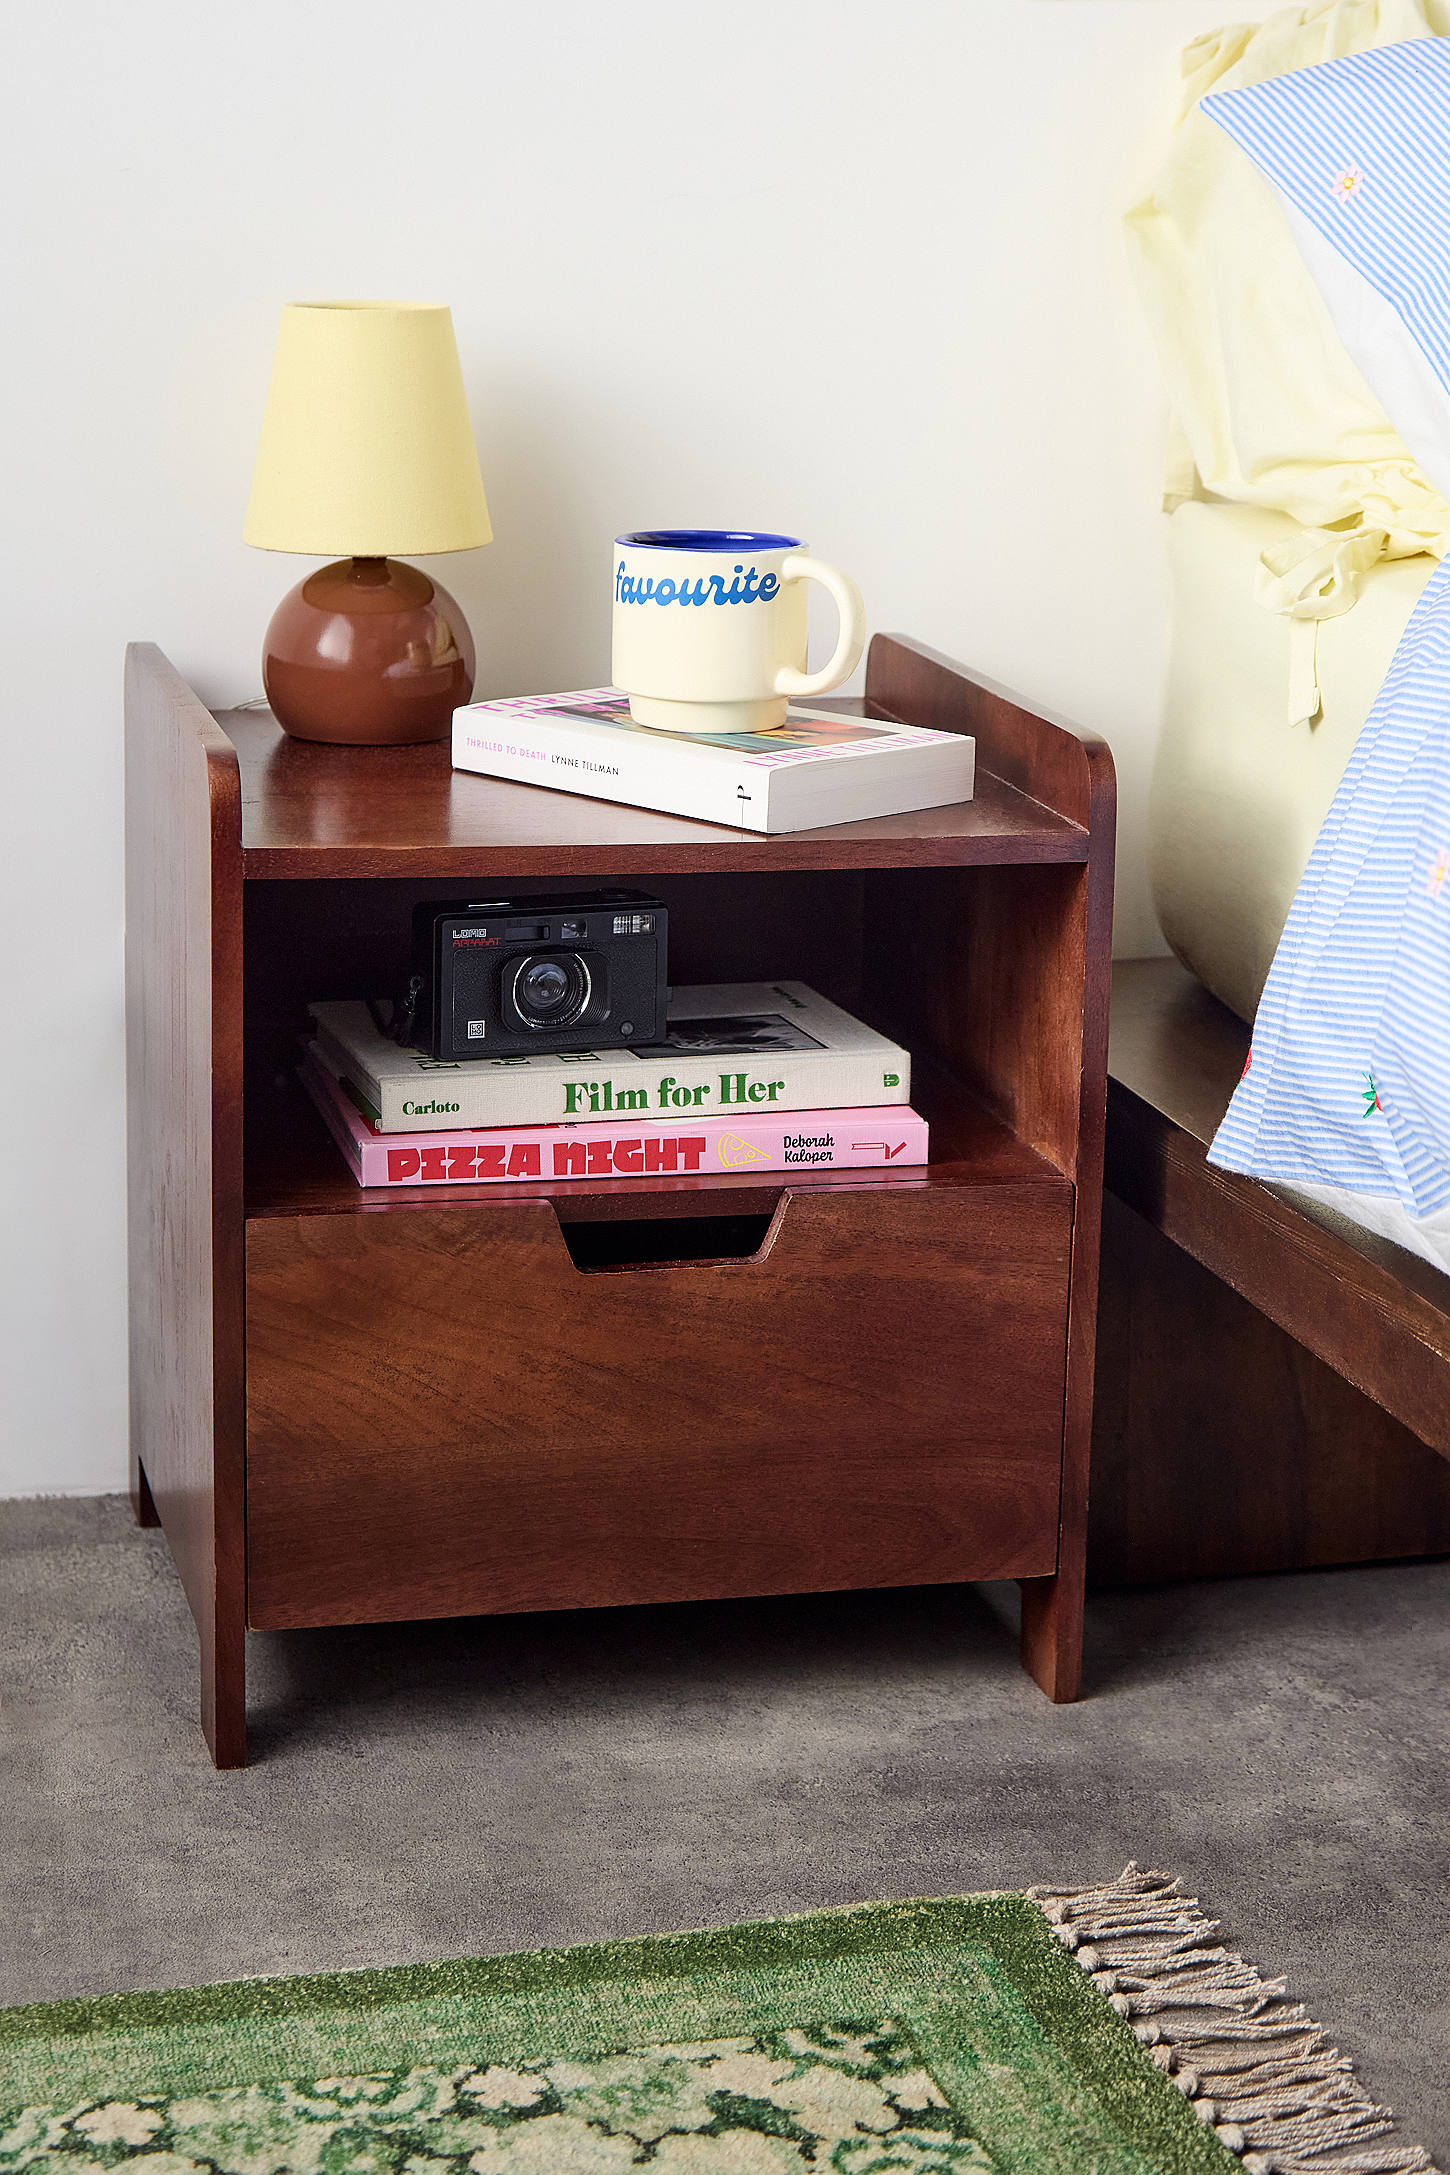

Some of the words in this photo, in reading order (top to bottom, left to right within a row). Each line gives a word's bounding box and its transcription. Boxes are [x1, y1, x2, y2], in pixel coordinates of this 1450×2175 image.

[616, 561, 781, 606] favourite
[472, 689, 628, 712] THRILL
[466, 737, 503, 753] THRILLED
[506, 745, 517, 756] TO
[519, 748, 546, 761] DEATH
[551, 754, 579, 768] LYNNE
[582, 760, 619, 776] TILLMAN
[743, 749, 846, 767] LYNNE
[832, 731, 960, 753] TILLMAN
[452, 928, 487, 939] LOMO
[452, 937, 504, 949] APPARAT
[402, 1100, 461, 1116] Carloto
[562, 1080, 650, 1114] Film
[657, 1077, 711, 1108] for
[718, 1073, 785, 1104] Her
[783, 1132, 836, 1149] Deborah
[387, 1144, 541, 1182] PIZZA
[552, 1137, 707, 1176] NIGHT
[784, 1148, 834, 1164] Kaloper
